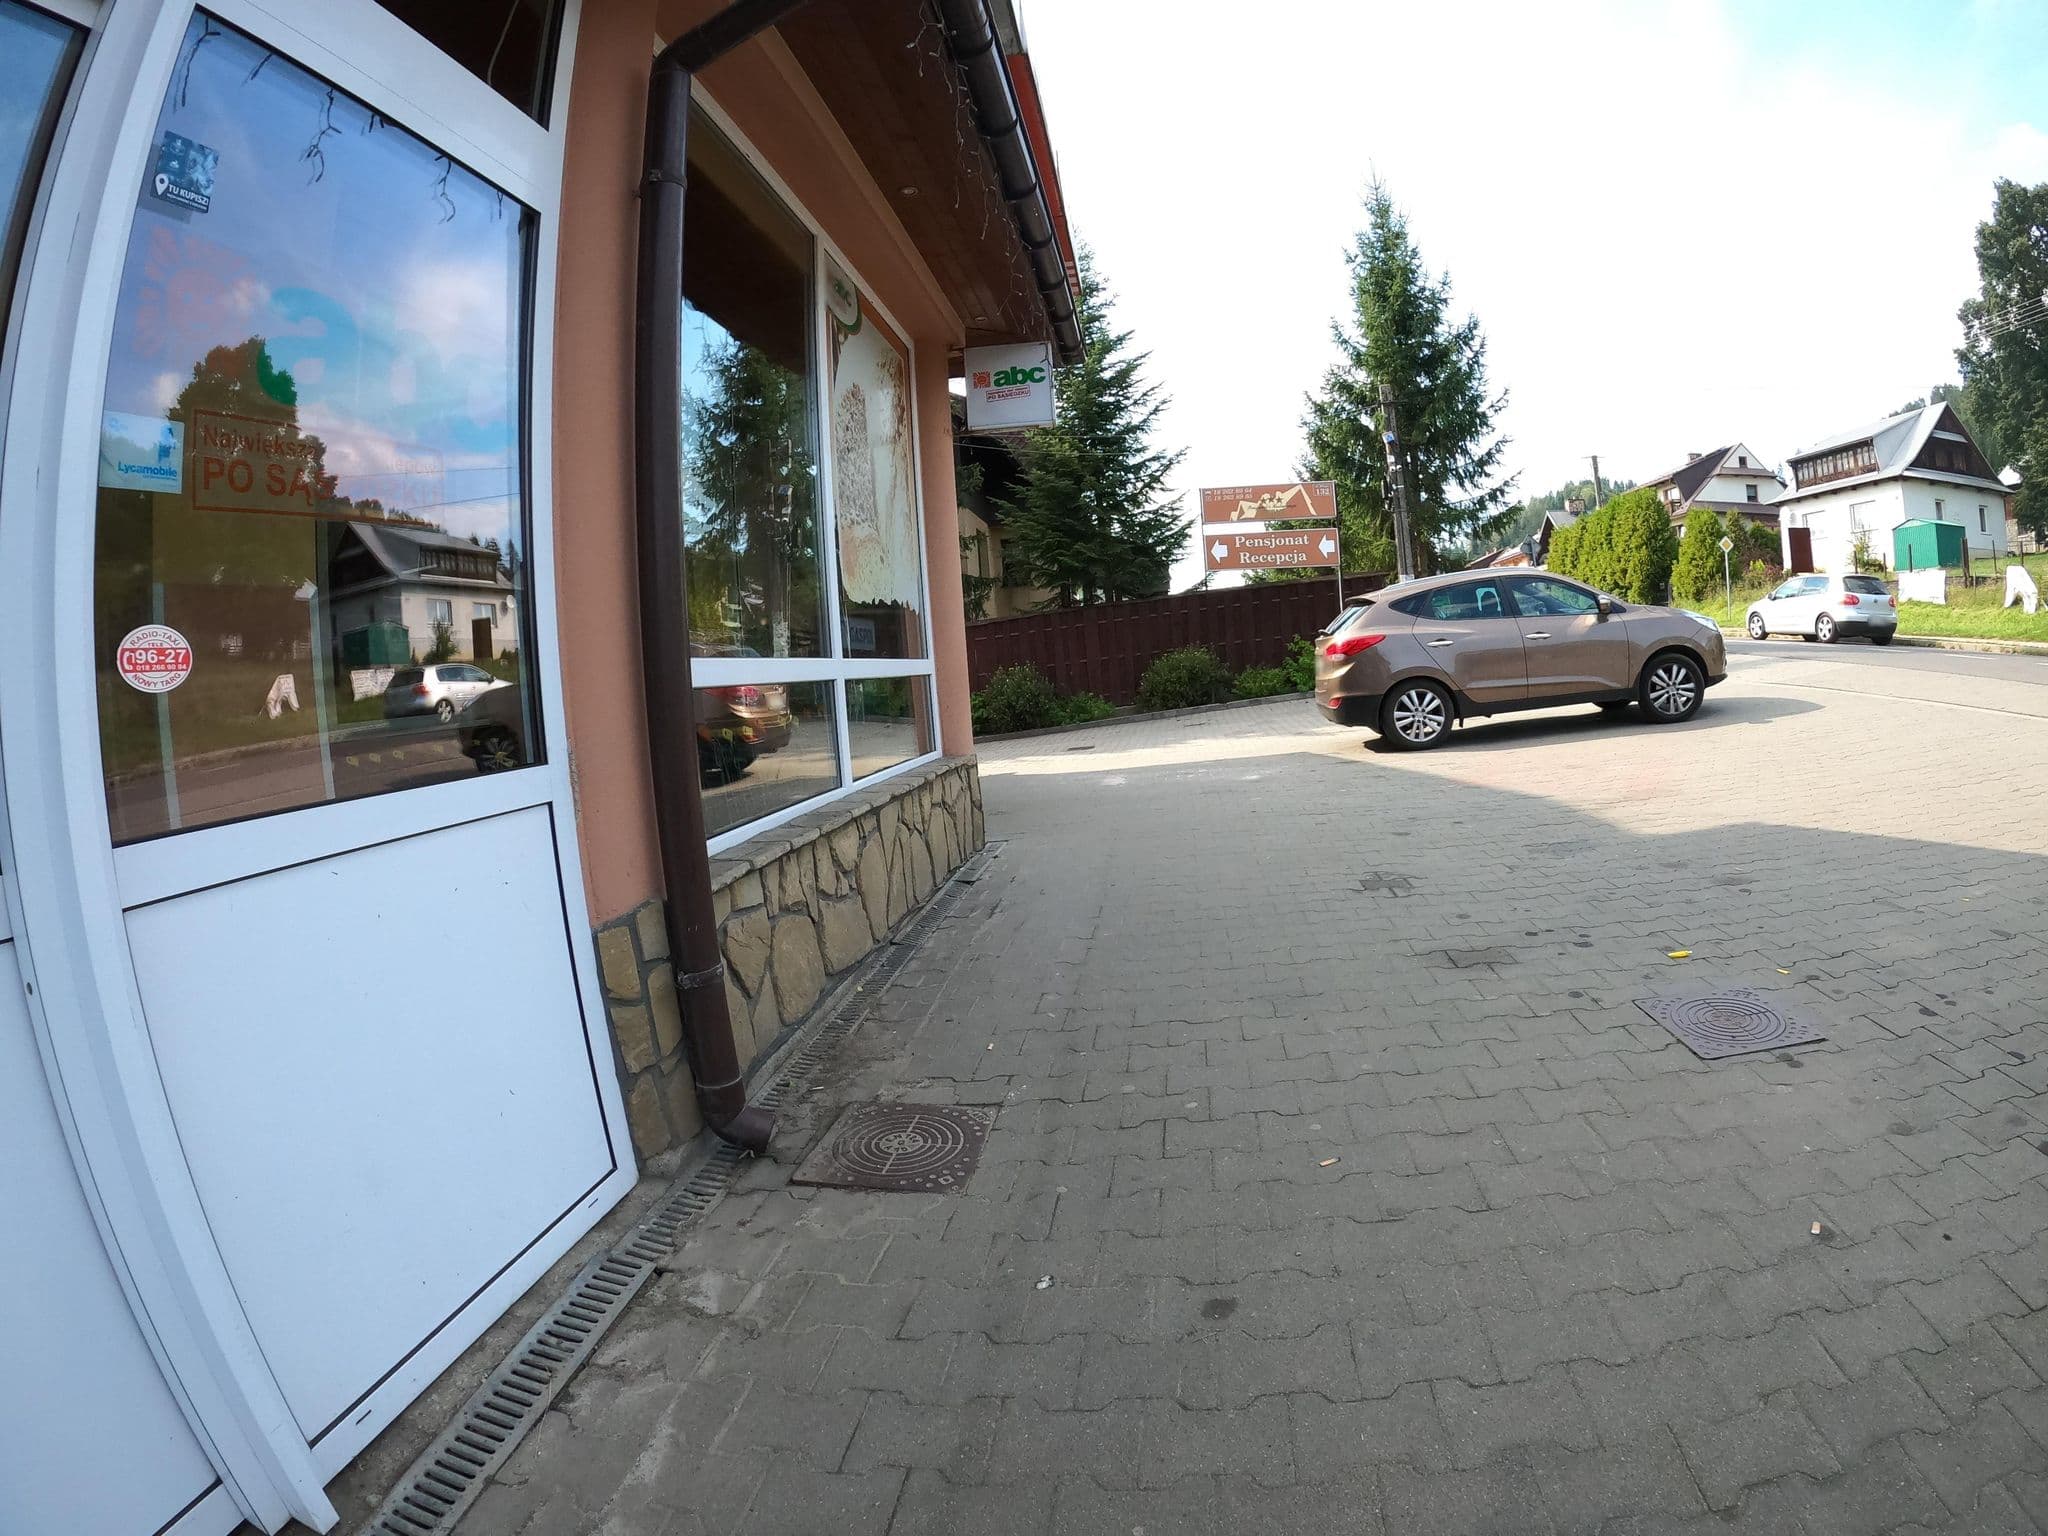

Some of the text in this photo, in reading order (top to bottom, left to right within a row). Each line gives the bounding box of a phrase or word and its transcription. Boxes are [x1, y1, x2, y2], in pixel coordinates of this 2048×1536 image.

[169, 184, 180, 194] TU
[993, 366, 1046, 387] abc
[118, 460, 177, 478] Lycamobile
[203, 456, 253, 494] PO
[1235, 533, 1310, 549] Pensjonat
[1239, 550, 1307, 565] Recepcja
[130, 631, 181, 647] RADIO-TAXI
[132, 672, 182, 689] NOWY TARG
